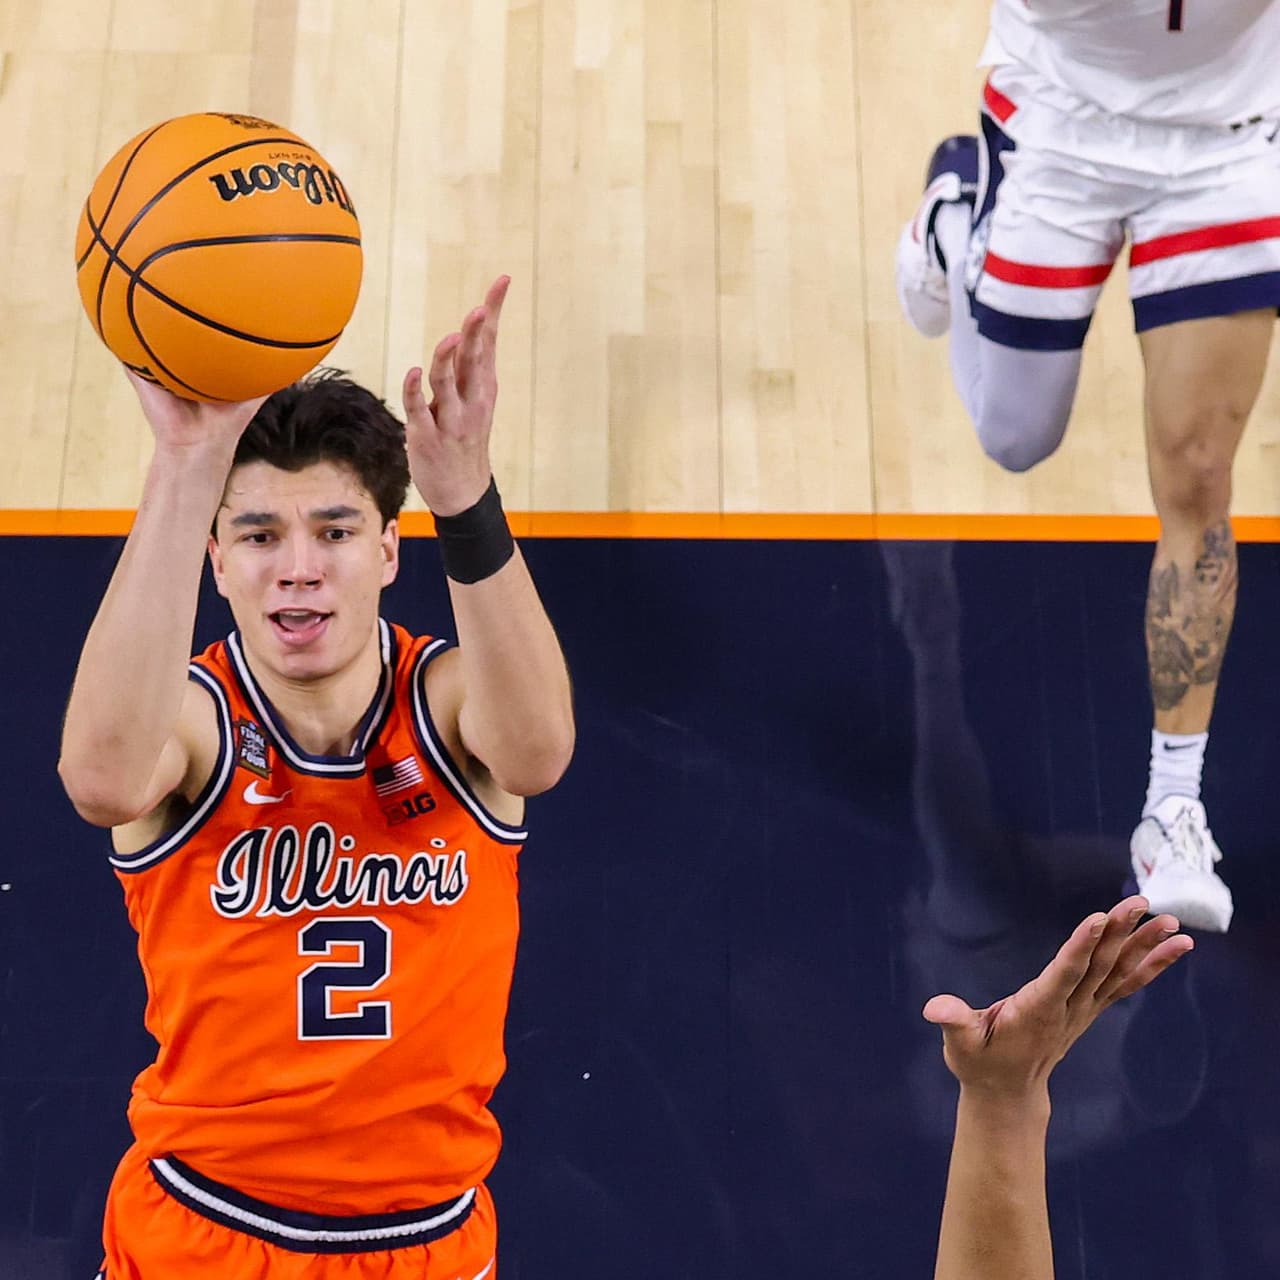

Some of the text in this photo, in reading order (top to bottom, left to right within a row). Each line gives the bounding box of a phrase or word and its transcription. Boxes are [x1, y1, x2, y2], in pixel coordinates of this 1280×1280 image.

[240, 747, 267, 769] FOUR
[210, 821, 470, 919] Illinois
[297, 916, 392, 1040] 2
